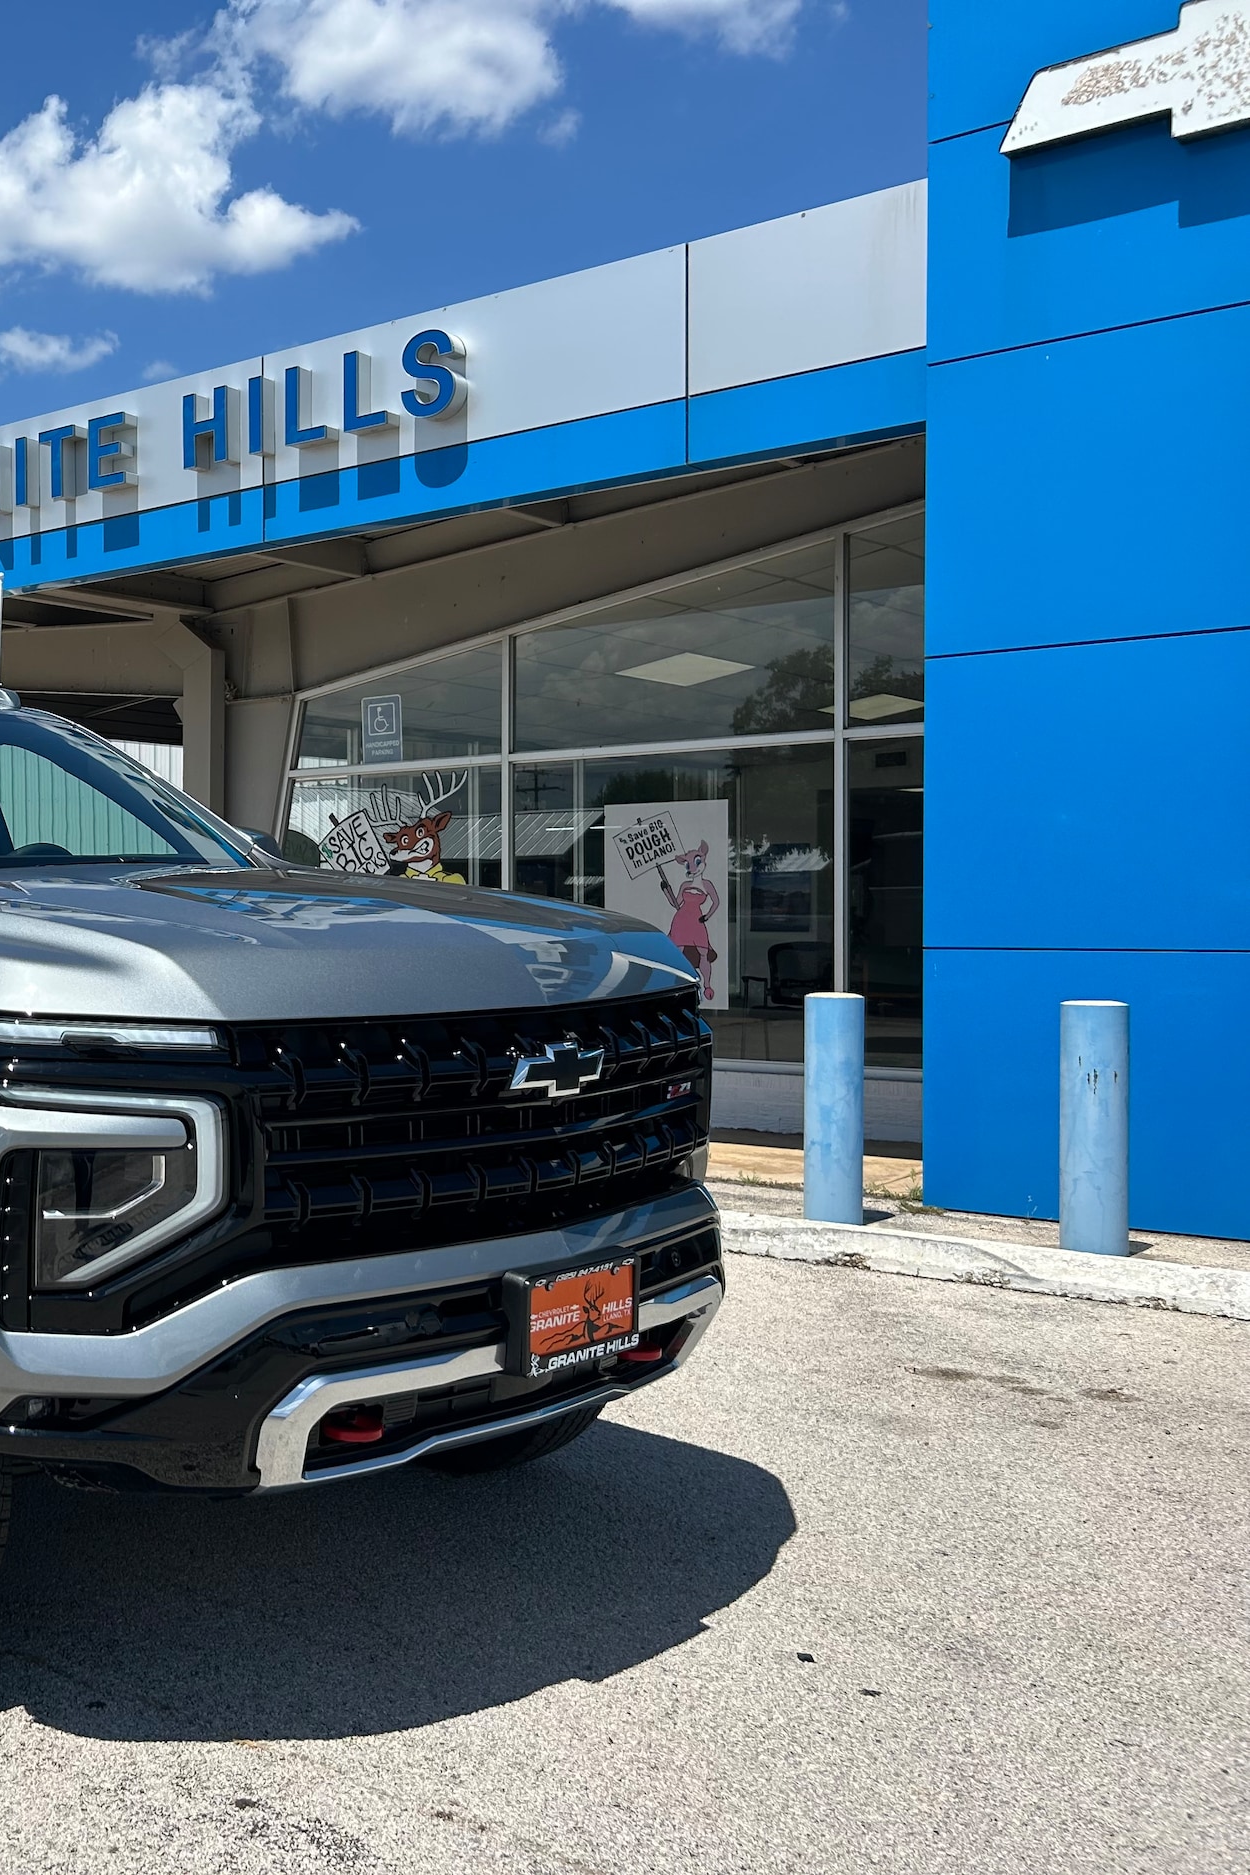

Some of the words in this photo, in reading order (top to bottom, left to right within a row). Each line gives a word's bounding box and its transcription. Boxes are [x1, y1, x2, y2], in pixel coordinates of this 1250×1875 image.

[183, 328, 466, 471] HILLS
[365, 740, 400, 748] HANDICAPPED
[372, 748, 394, 756] PARKING
[329, 816, 367, 854] SAVE
[625, 828, 672, 860] DOUGH
[627, 828, 648, 843] Save
[336, 837, 374, 872] BIG
[642, 841, 676, 864] LLANO!
[667, 1082, 691, 1099] Z71
[538, 1305, 570, 1319] CHEVROLET
[602, 1296, 633, 1315] HILLS
[624, 1308, 632, 1316] TX
[548, 1343, 606, 1371] GRANITE
[606, 1333, 640, 1354] HILLS
